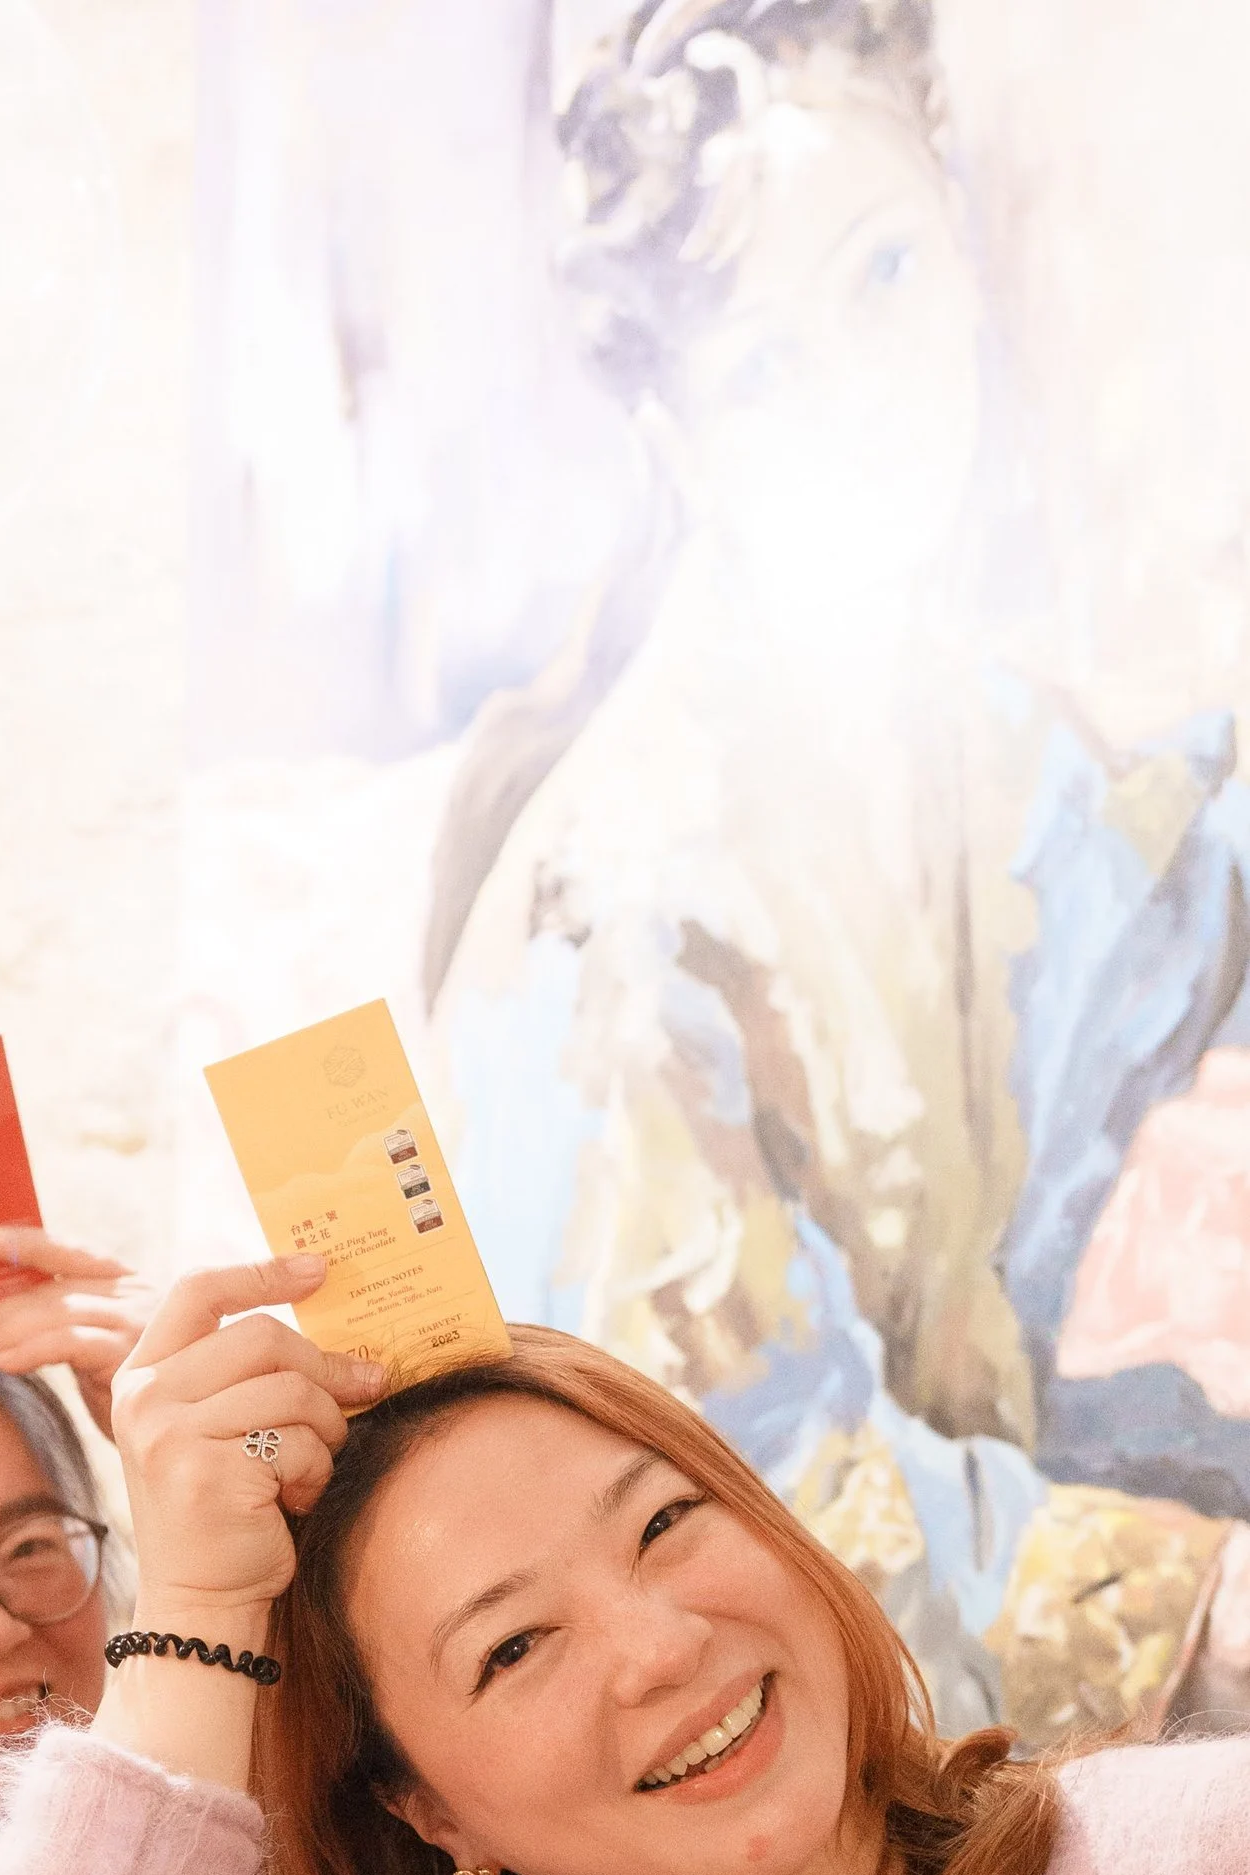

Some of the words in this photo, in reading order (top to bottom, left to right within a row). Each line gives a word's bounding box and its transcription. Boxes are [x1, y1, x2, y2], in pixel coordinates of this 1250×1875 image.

[326, 1101, 348, 1120] FU
[351, 1087, 389, 1108] WAN
[339, 1250, 353, 1263] Sel
[355, 1236, 397, 1257] Chocolate
[346, 1233, 367, 1248] Ping
[368, 1227, 389, 1241] Tung
[349, 1277, 391, 1299] TASTING
[391, 1264, 424, 1283] NOTES
[418, 1313, 462, 1336] HARVEST
[431, 1330, 460, 1348] 2023
